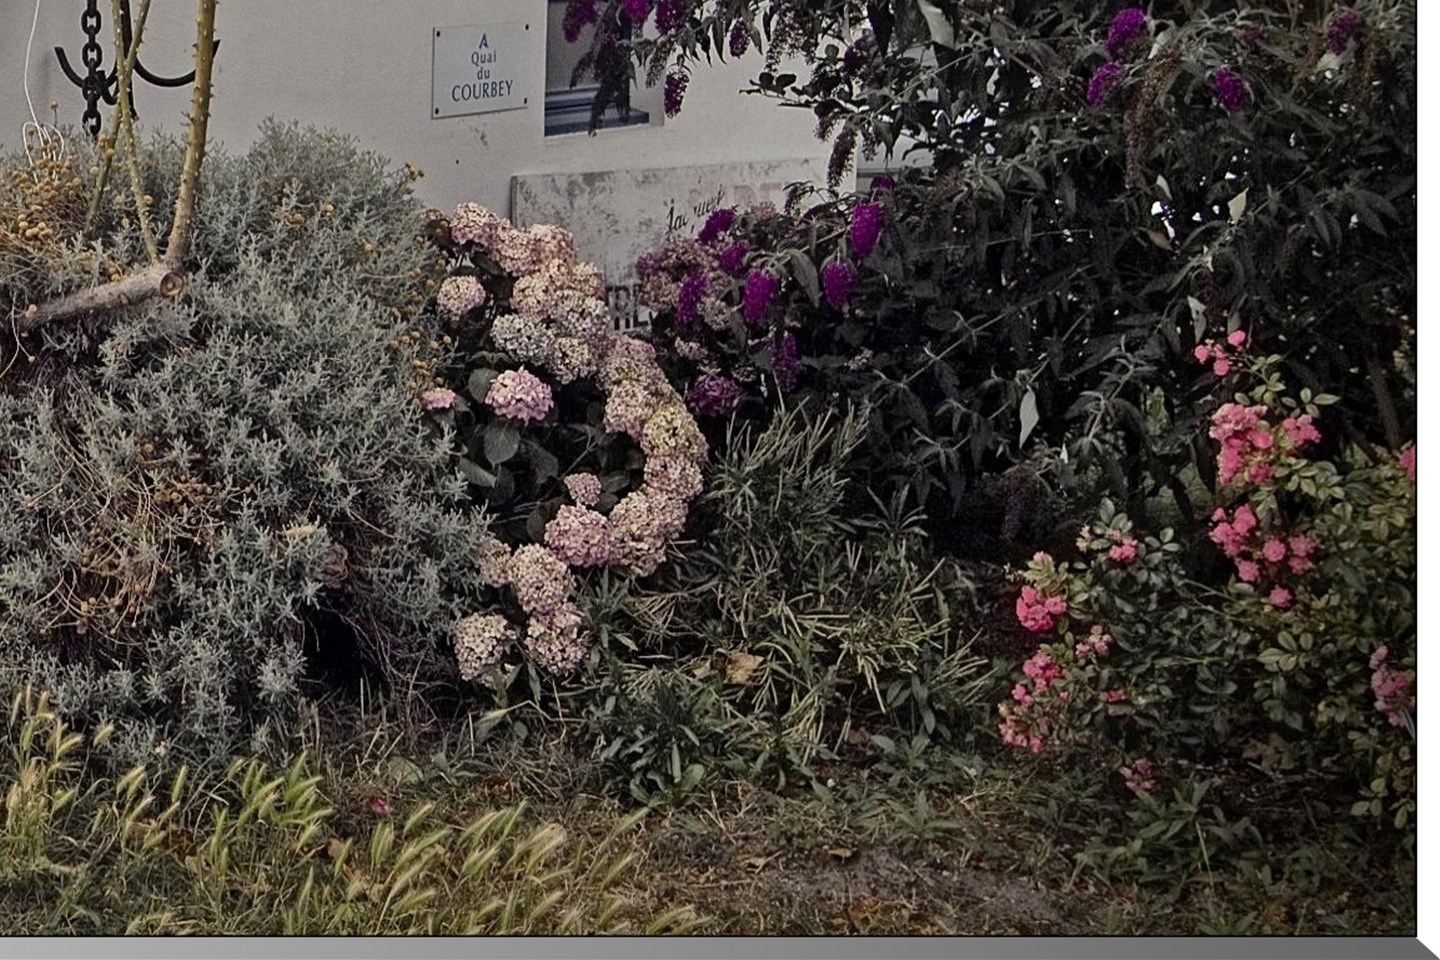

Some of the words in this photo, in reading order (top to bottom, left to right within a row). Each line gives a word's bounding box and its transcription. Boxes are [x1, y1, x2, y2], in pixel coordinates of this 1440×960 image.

[479, 33, 489, 49] A
[471, 50, 497, 67] Quai
[477, 67, 491, 80] du
[451, 80, 513, 102] COURBEY
